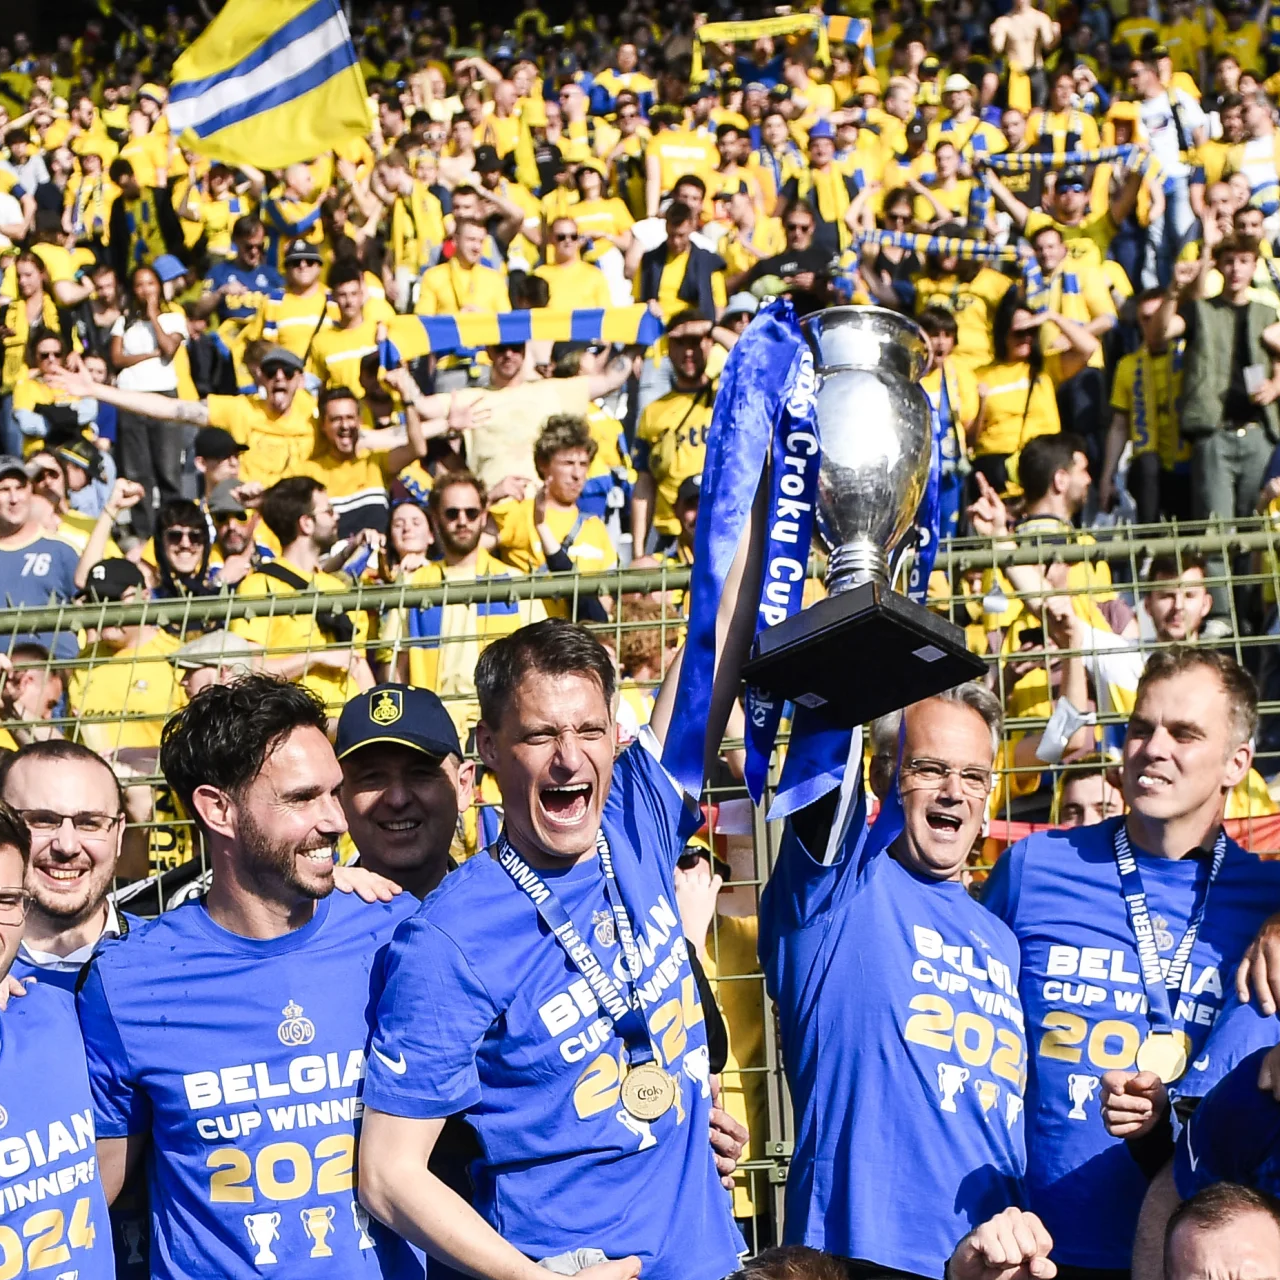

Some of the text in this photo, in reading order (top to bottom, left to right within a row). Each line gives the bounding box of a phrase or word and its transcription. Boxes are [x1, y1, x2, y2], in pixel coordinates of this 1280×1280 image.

[771, 432, 818, 544] Croky
[21, 553, 52, 577] 76
[759, 557, 803, 627] Cup
[912, 960, 969, 994] CUP
[1133, 912, 1163, 985] WINNER
[570, 943, 629, 1020] WINNER
[1043, 980, 1107, 1006] CUP
[559, 1016, 615, 1063] CUP
[904, 994, 1027, 1086] 202
[197, 1111, 263, 1140] CUP
